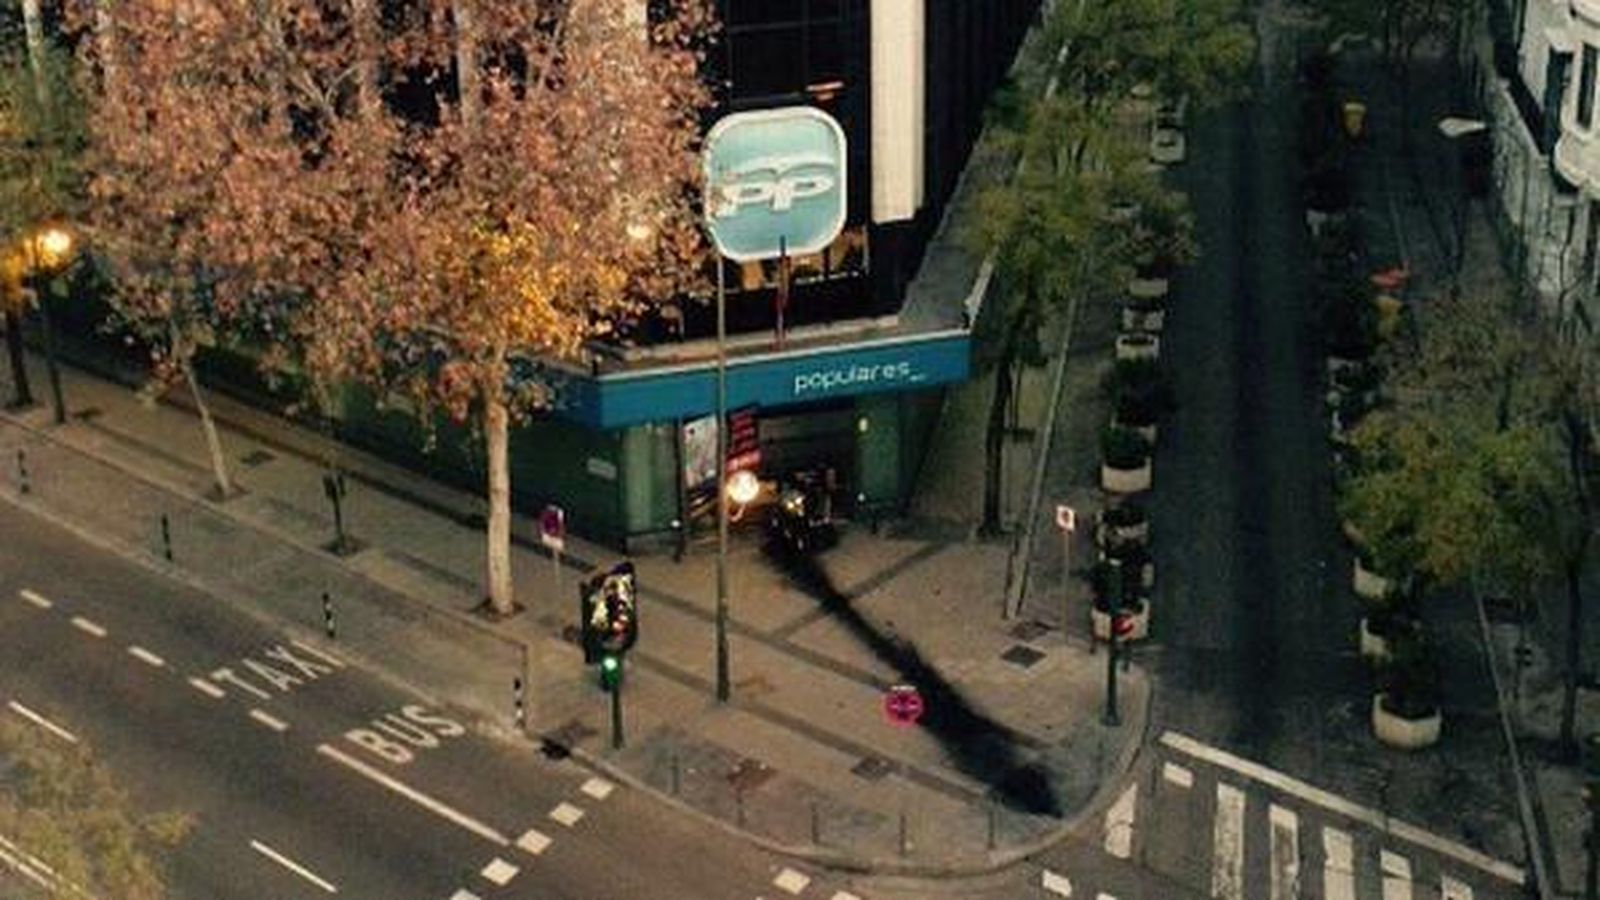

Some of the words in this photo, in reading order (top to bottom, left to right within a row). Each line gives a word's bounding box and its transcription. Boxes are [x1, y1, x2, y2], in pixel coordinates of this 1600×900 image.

[794, 362, 910, 395] populares
[211, 640, 346, 699] TAXI
[344, 704, 465, 764] BUS
